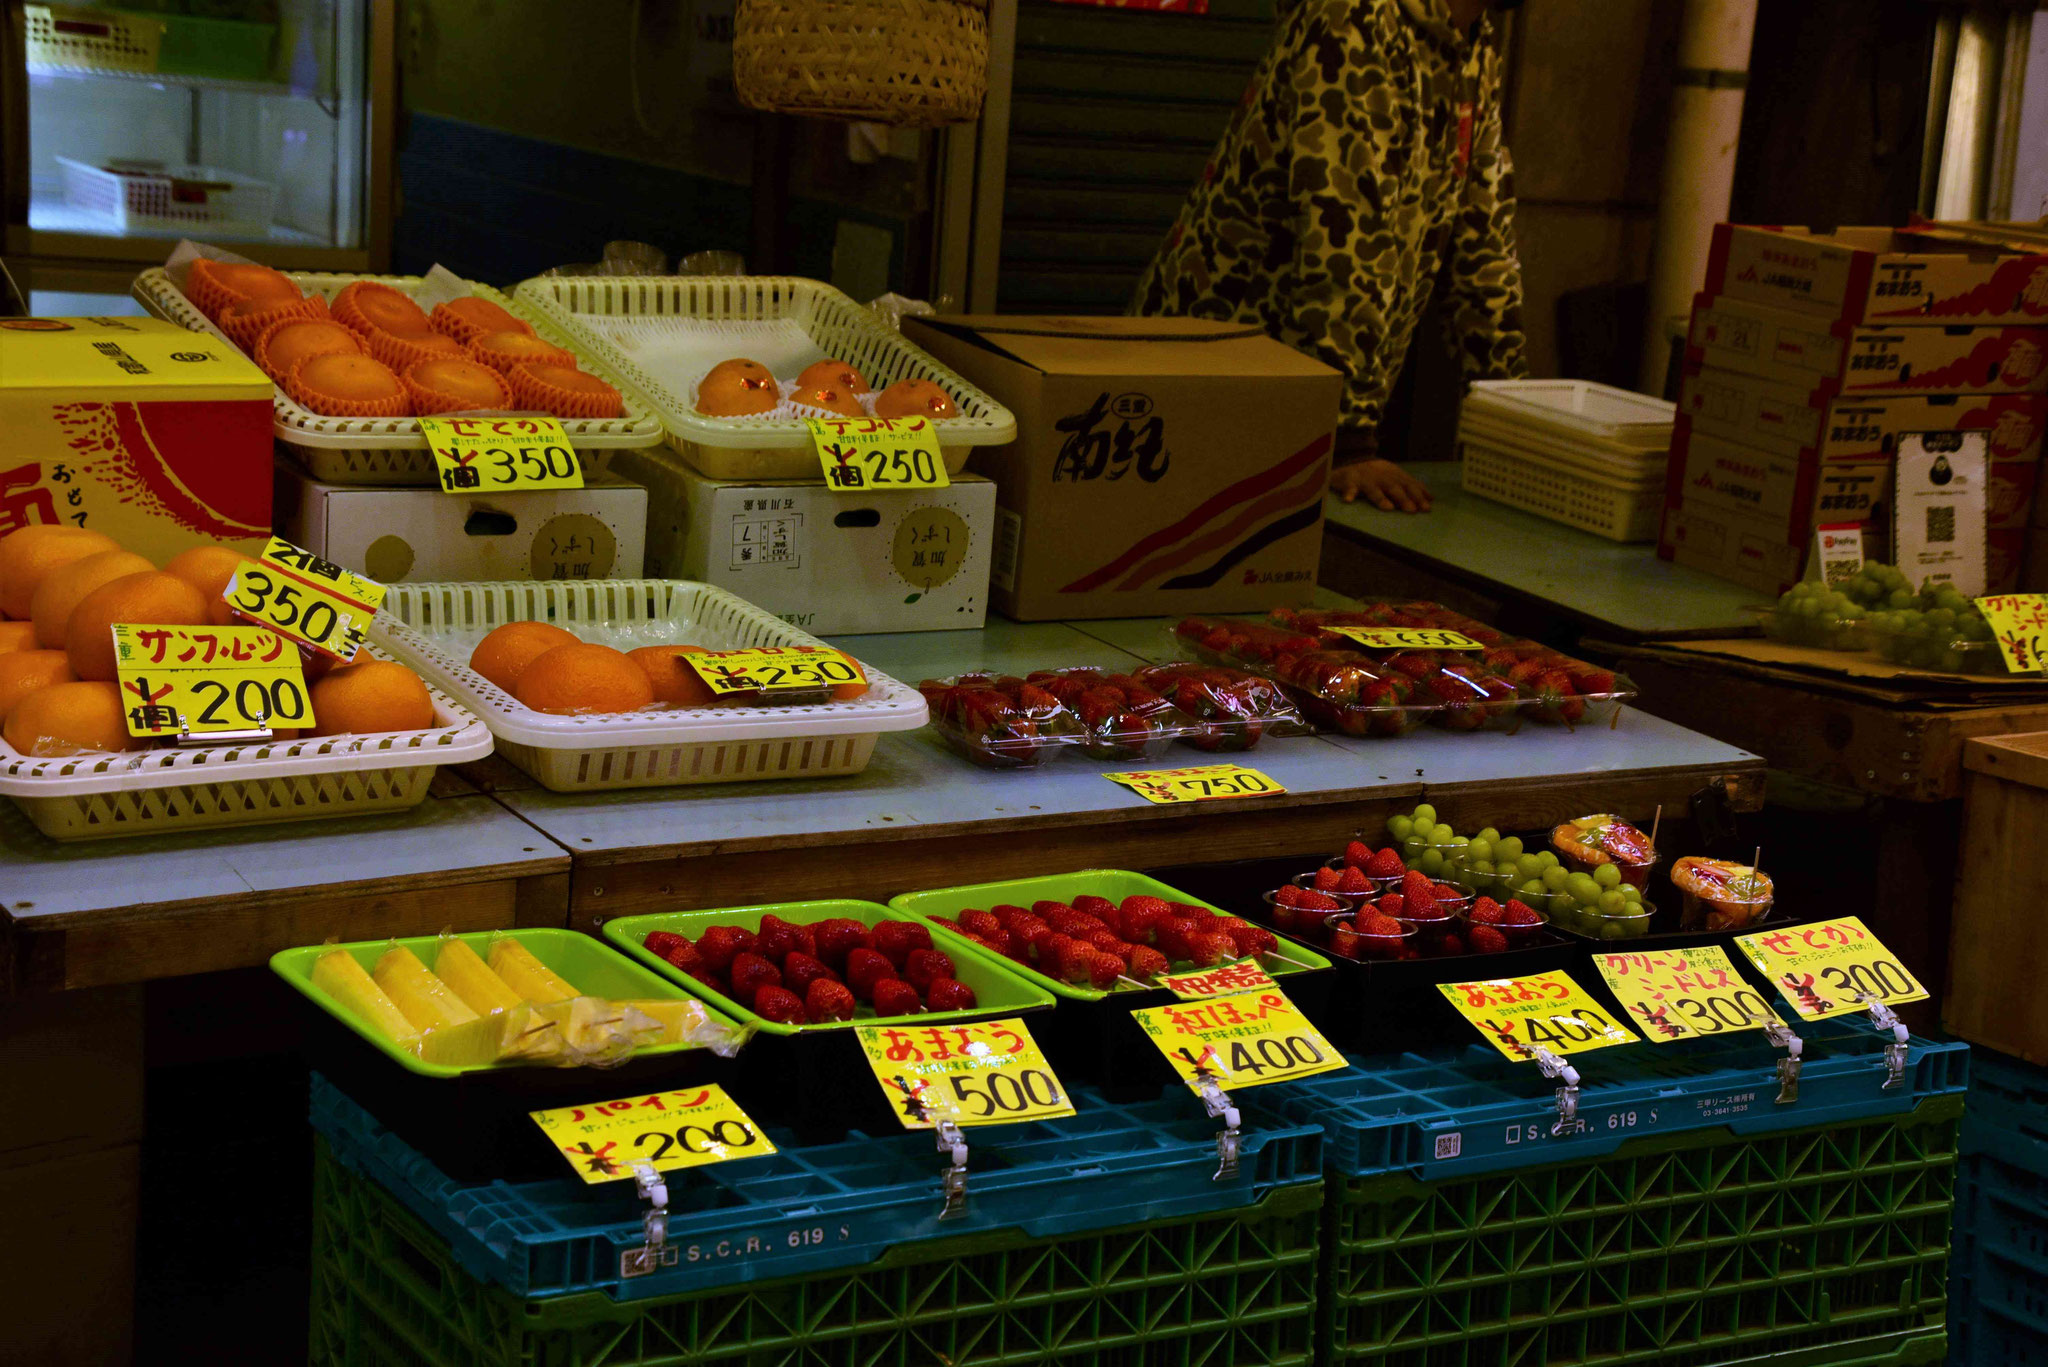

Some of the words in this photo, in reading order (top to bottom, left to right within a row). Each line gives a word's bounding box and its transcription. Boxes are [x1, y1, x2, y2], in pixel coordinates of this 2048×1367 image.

[1118, 399, 1146, 412] 三重
[443, 419, 555, 437] せとか
[485, 446, 575, 484] 350
[863, 448, 938, 484] 250
[51, 463, 89, 529] おもて
[743, 497, 795, 511] 石川県産
[550, 533, 595, 556] しずく
[742, 524, 750, 542] 7
[910, 524, 951, 545] しずく
[268, 540, 344, 582] 2個
[911, 549, 949, 567] 加賀
[233, 570, 338, 644] 350
[755, 660, 858, 686] 250
[189, 677, 306, 726] 200
[1179, 773, 1270, 797] 750
[1761, 923, 1866, 956] せとか
[1605, 951, 1688, 976] グリーン
[1456, 974, 1571, 1009] あまおう
[1638, 968, 1739, 1001] シードレス
[1820, 960, 1916, 1004] 300
[1163, 994, 1291, 1036] 紅ほっぺ
[1675, 990, 1777, 1032] 300
[880, 1022, 1025, 1063] あまおう
[1524, 1008, 1614, 1051] 400
[1230, 1035, 1325, 1076] 400
[571, 1089, 710, 1123] パイン
[949, 1069, 1060, 1117] 500
[1607, 1110, 1638, 1130] 619
[1647, 1107, 1659, 1125] S
[633, 1119, 757, 1162] 200
[686, 1235, 773, 1263] S.C.R.
[787, 1226, 824, 1248] 619
[837, 1223, 850, 1242] S
